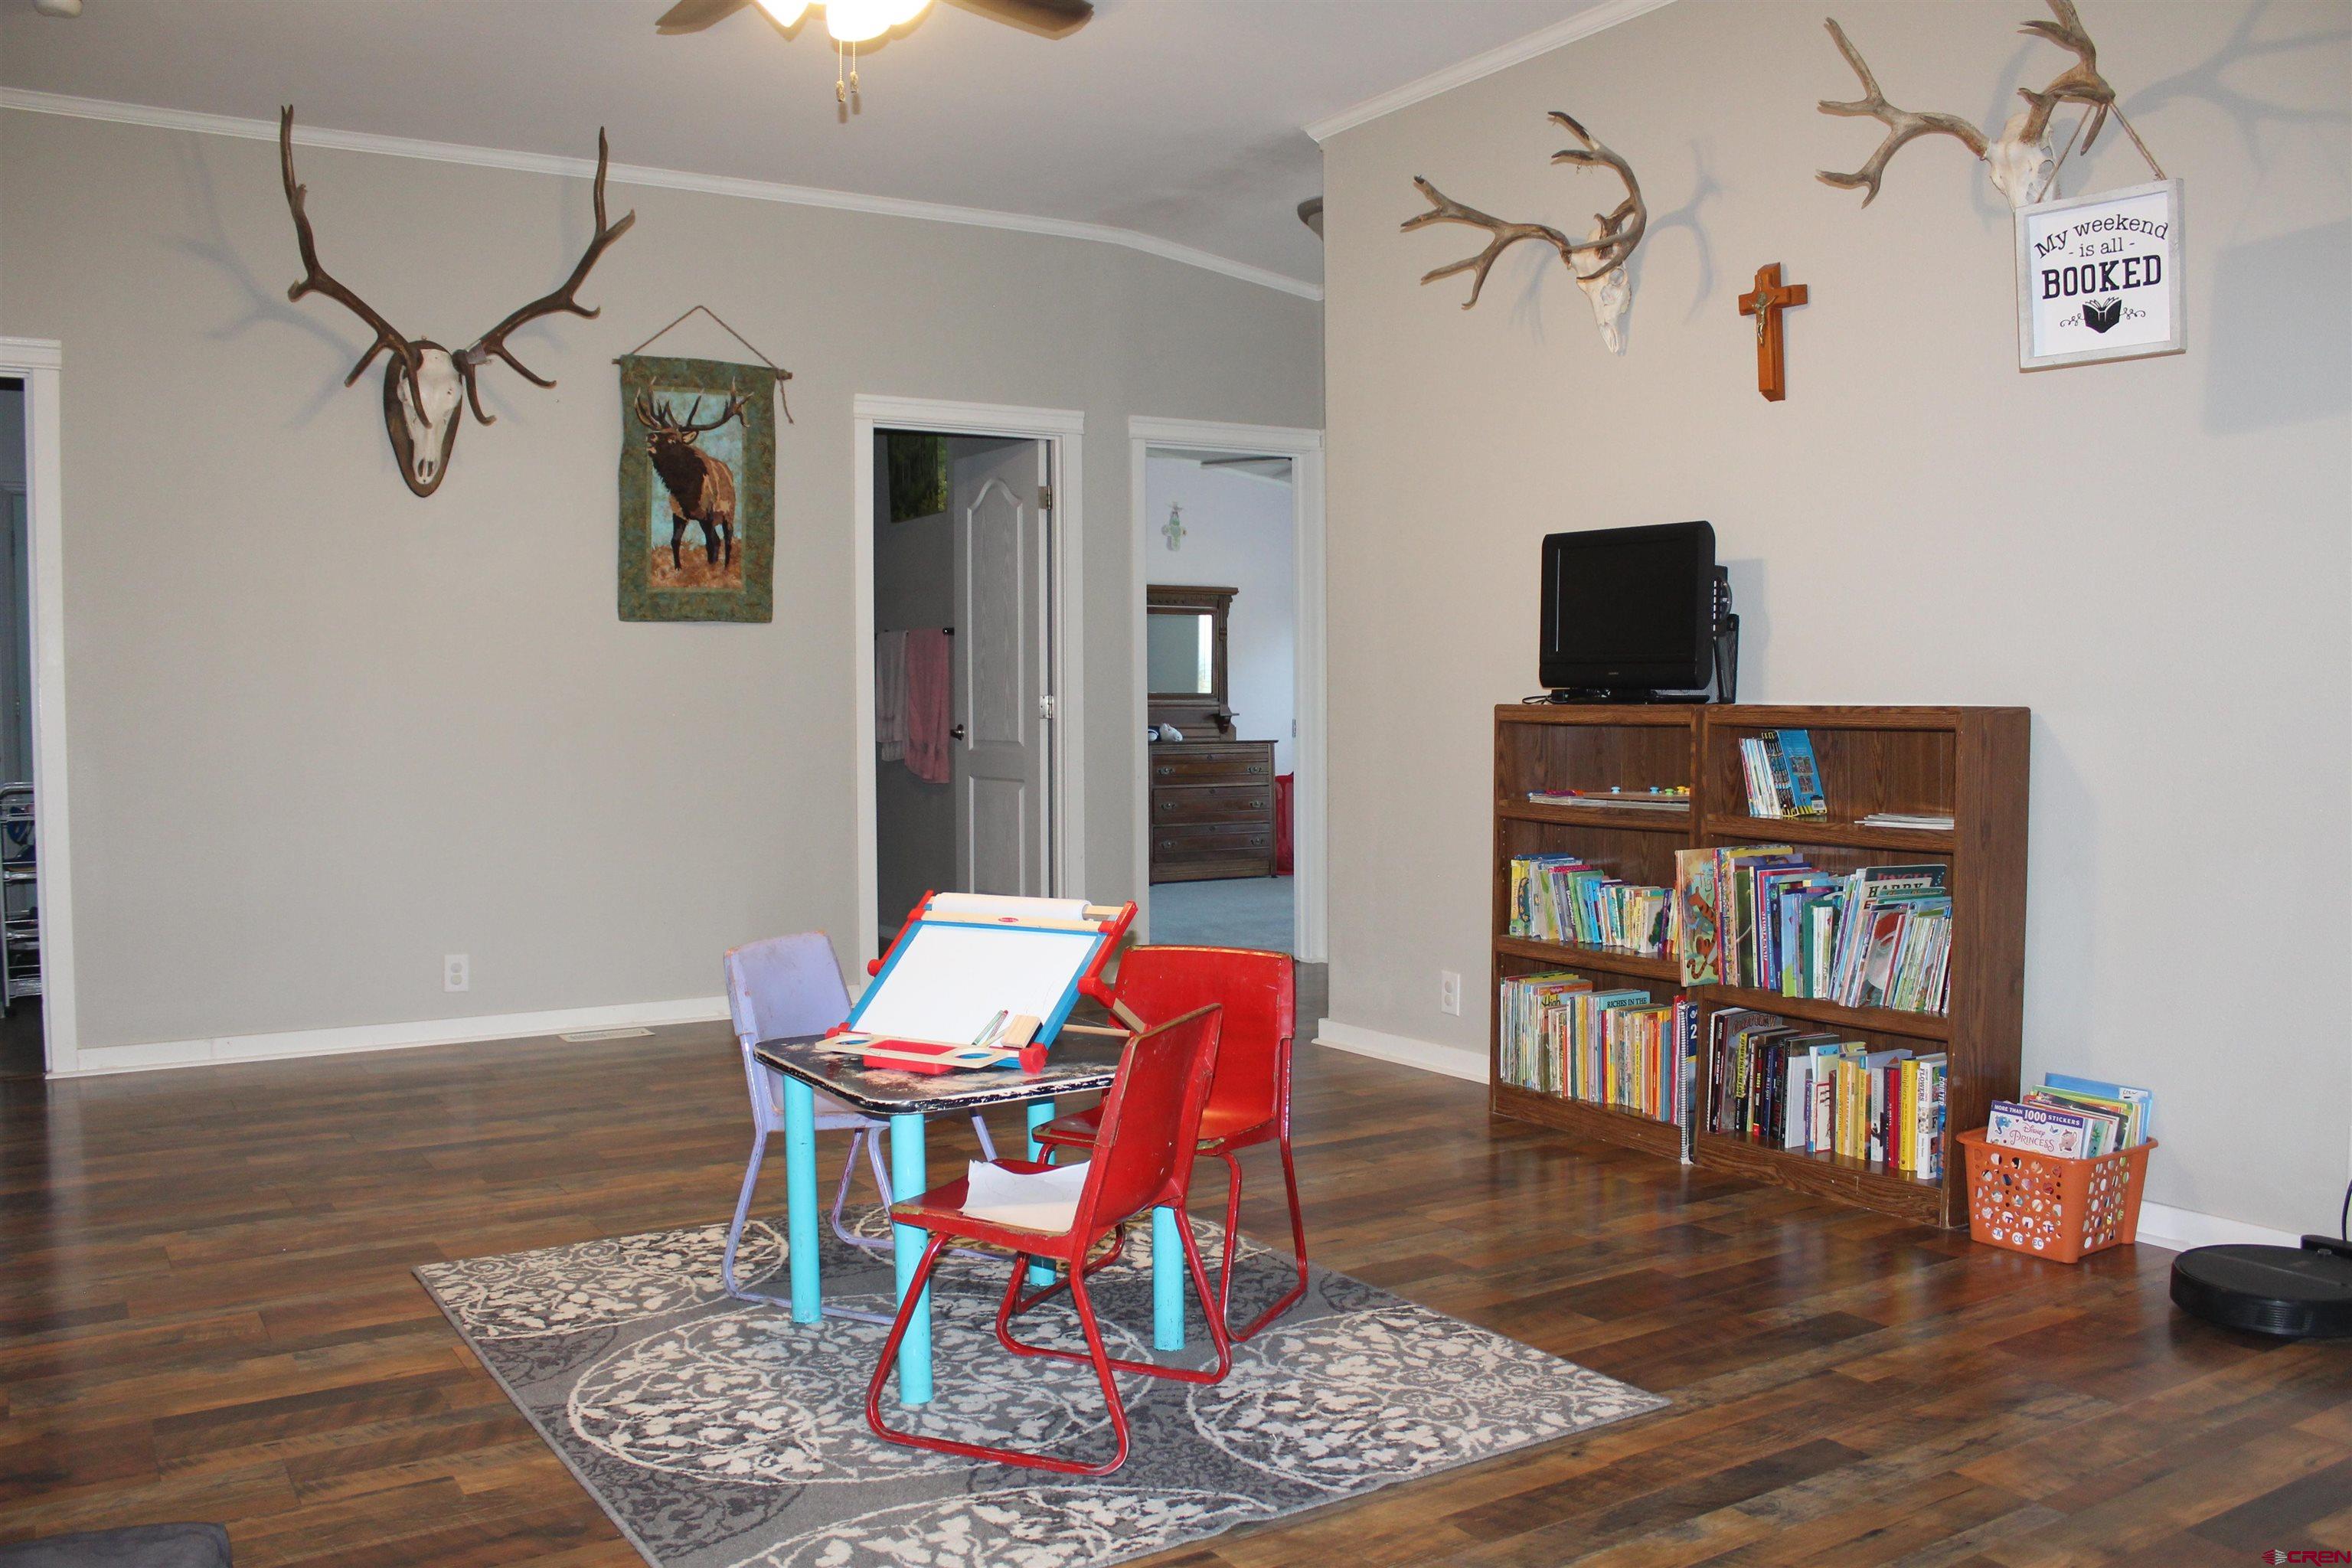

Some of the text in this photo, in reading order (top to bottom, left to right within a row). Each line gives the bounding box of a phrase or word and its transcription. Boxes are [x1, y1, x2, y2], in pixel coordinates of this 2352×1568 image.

[2034, 214, 2169, 259] My weekend
[2079, 237, 2124, 258] is all
[2041, 254, 2161, 299] BOOKED
[1607, 999, 1627, 1008] RICHES
[1690, 1024, 1697, 1040] 2
[2024, 1109, 2047, 1122] 1000
[2048, 1115, 2080, 1125] STICKERS
[2021, 1122, 2046, 1138] Disney
[2009, 1129, 2055, 1152] PRINCESS
